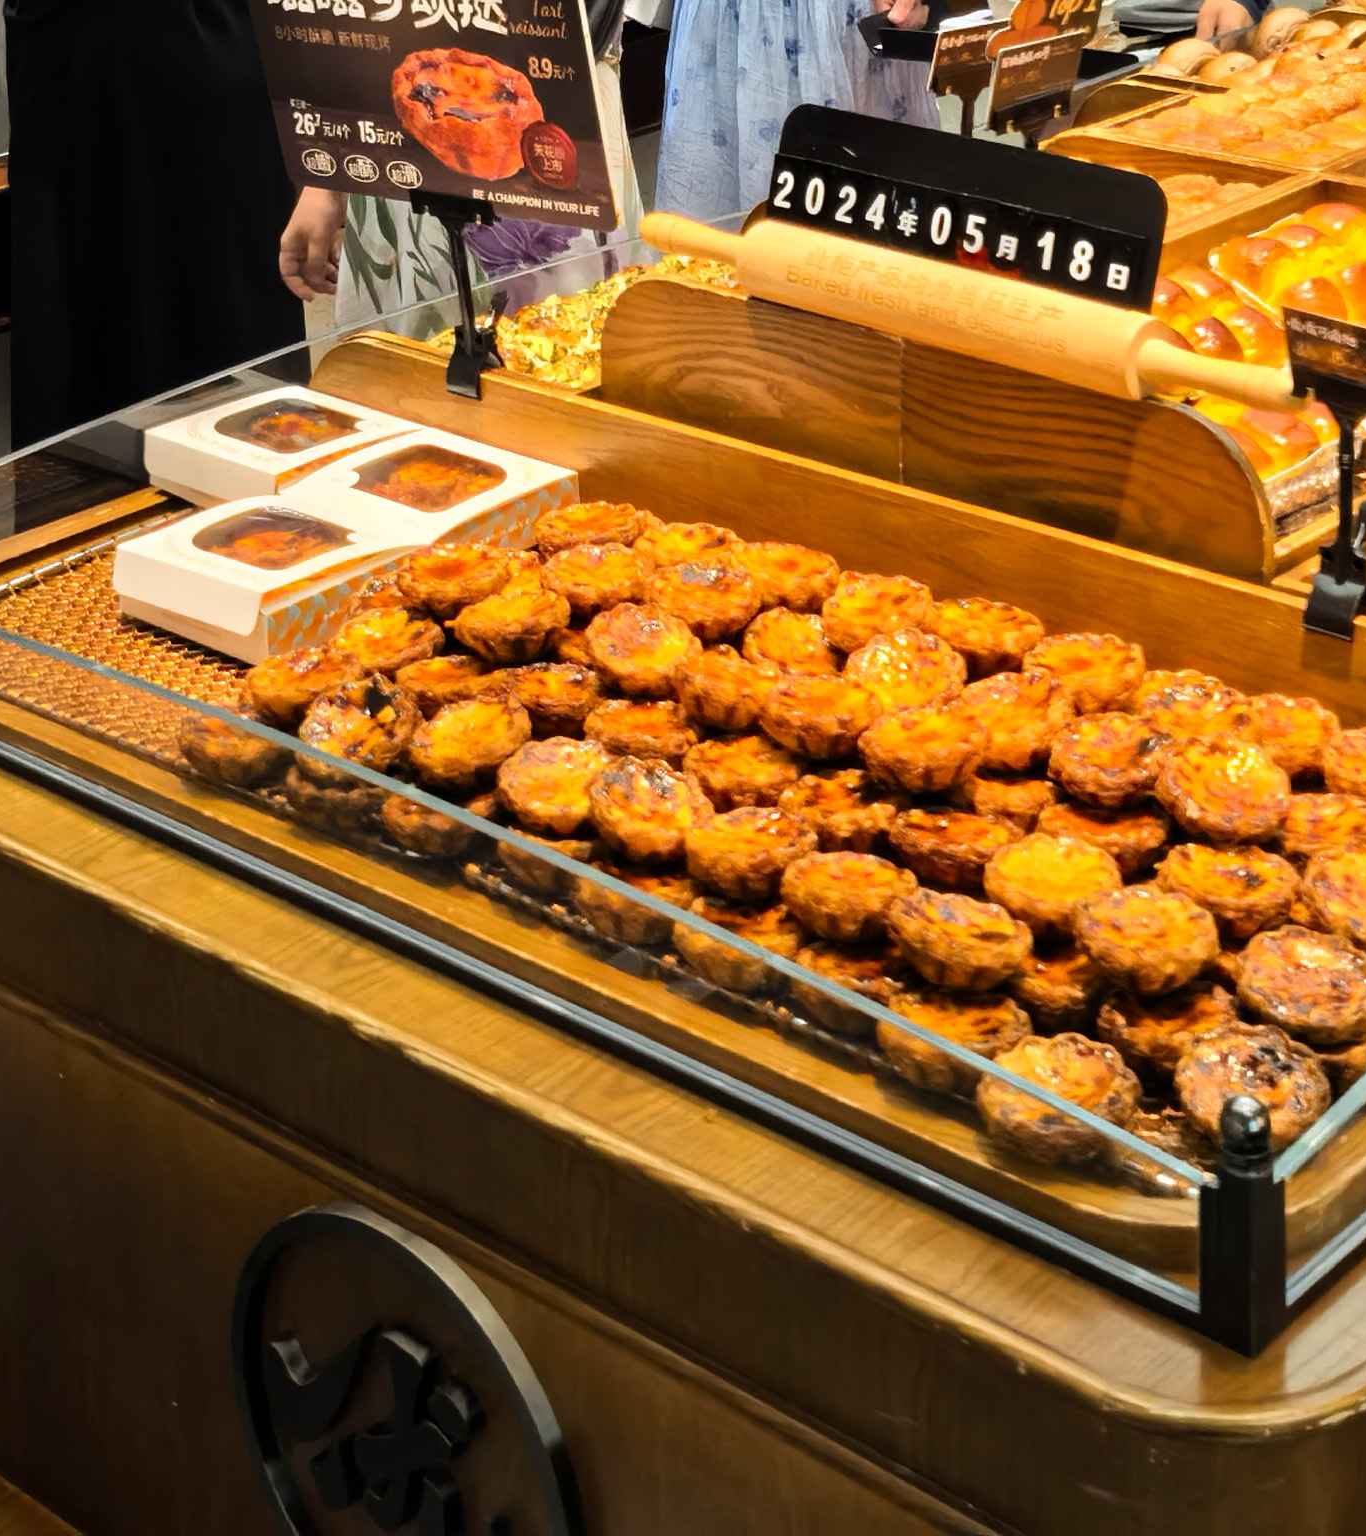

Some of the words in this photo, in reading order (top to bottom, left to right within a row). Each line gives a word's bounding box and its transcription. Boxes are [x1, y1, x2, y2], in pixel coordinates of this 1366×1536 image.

[473, 188, 485, 200] BE
[493, 192, 542, 209] CHAMPION
[553, 200, 579, 214] YOUR
